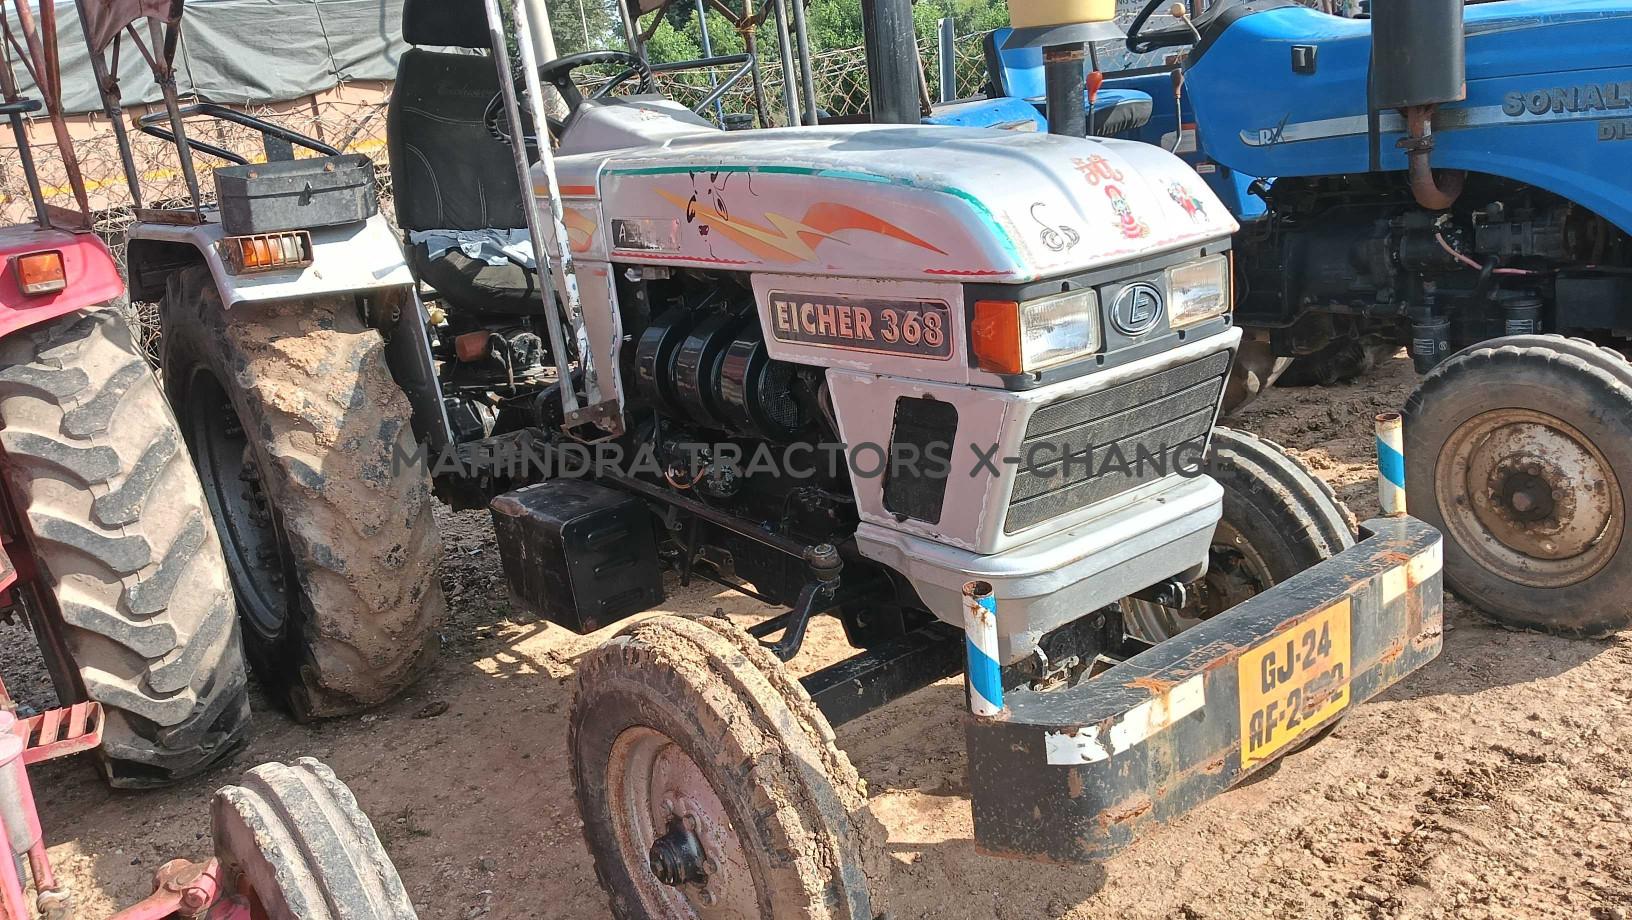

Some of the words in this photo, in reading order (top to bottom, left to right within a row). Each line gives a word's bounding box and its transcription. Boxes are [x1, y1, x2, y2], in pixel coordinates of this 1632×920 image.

[774, 301, 874, 341] EICHER
[881, 308, 944, 347] 368
[1261, 620, 1331, 694] GJ-24
